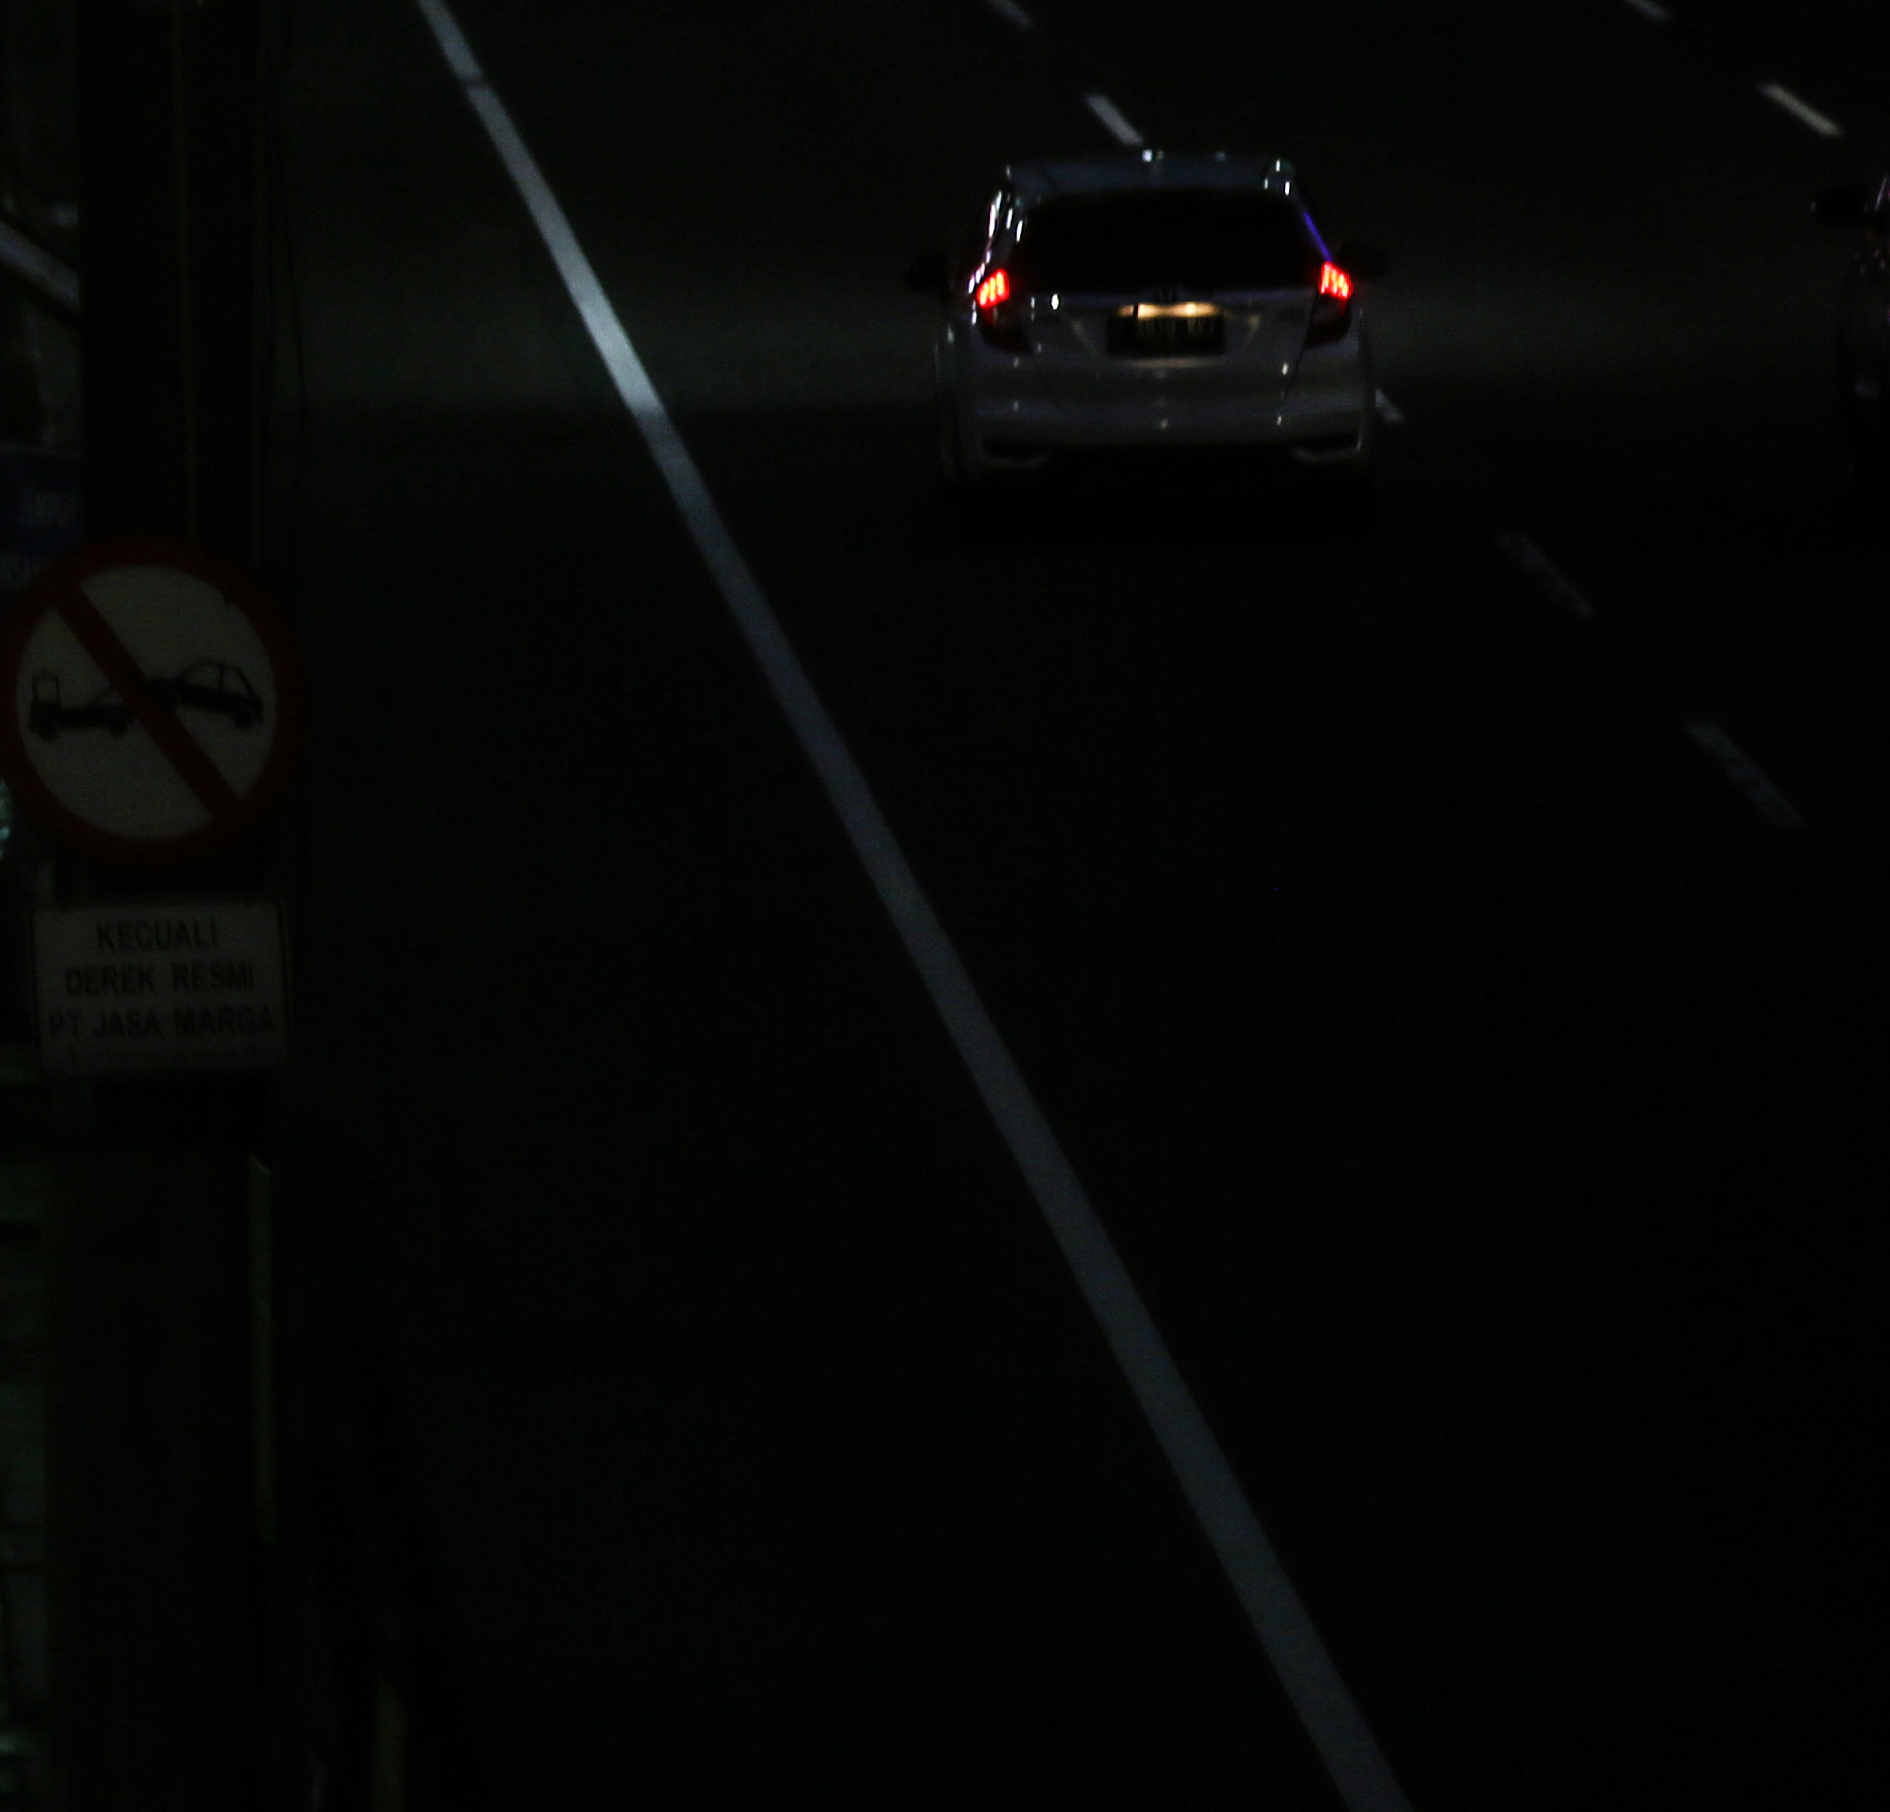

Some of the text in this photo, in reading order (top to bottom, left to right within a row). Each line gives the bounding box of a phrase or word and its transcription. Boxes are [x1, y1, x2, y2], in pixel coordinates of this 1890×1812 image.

[96, 920, 218, 953] KECUALI
[64, 962, 254, 996] DEREK RESMI
[48, 1003, 276, 1038] PT JASA MARGA
